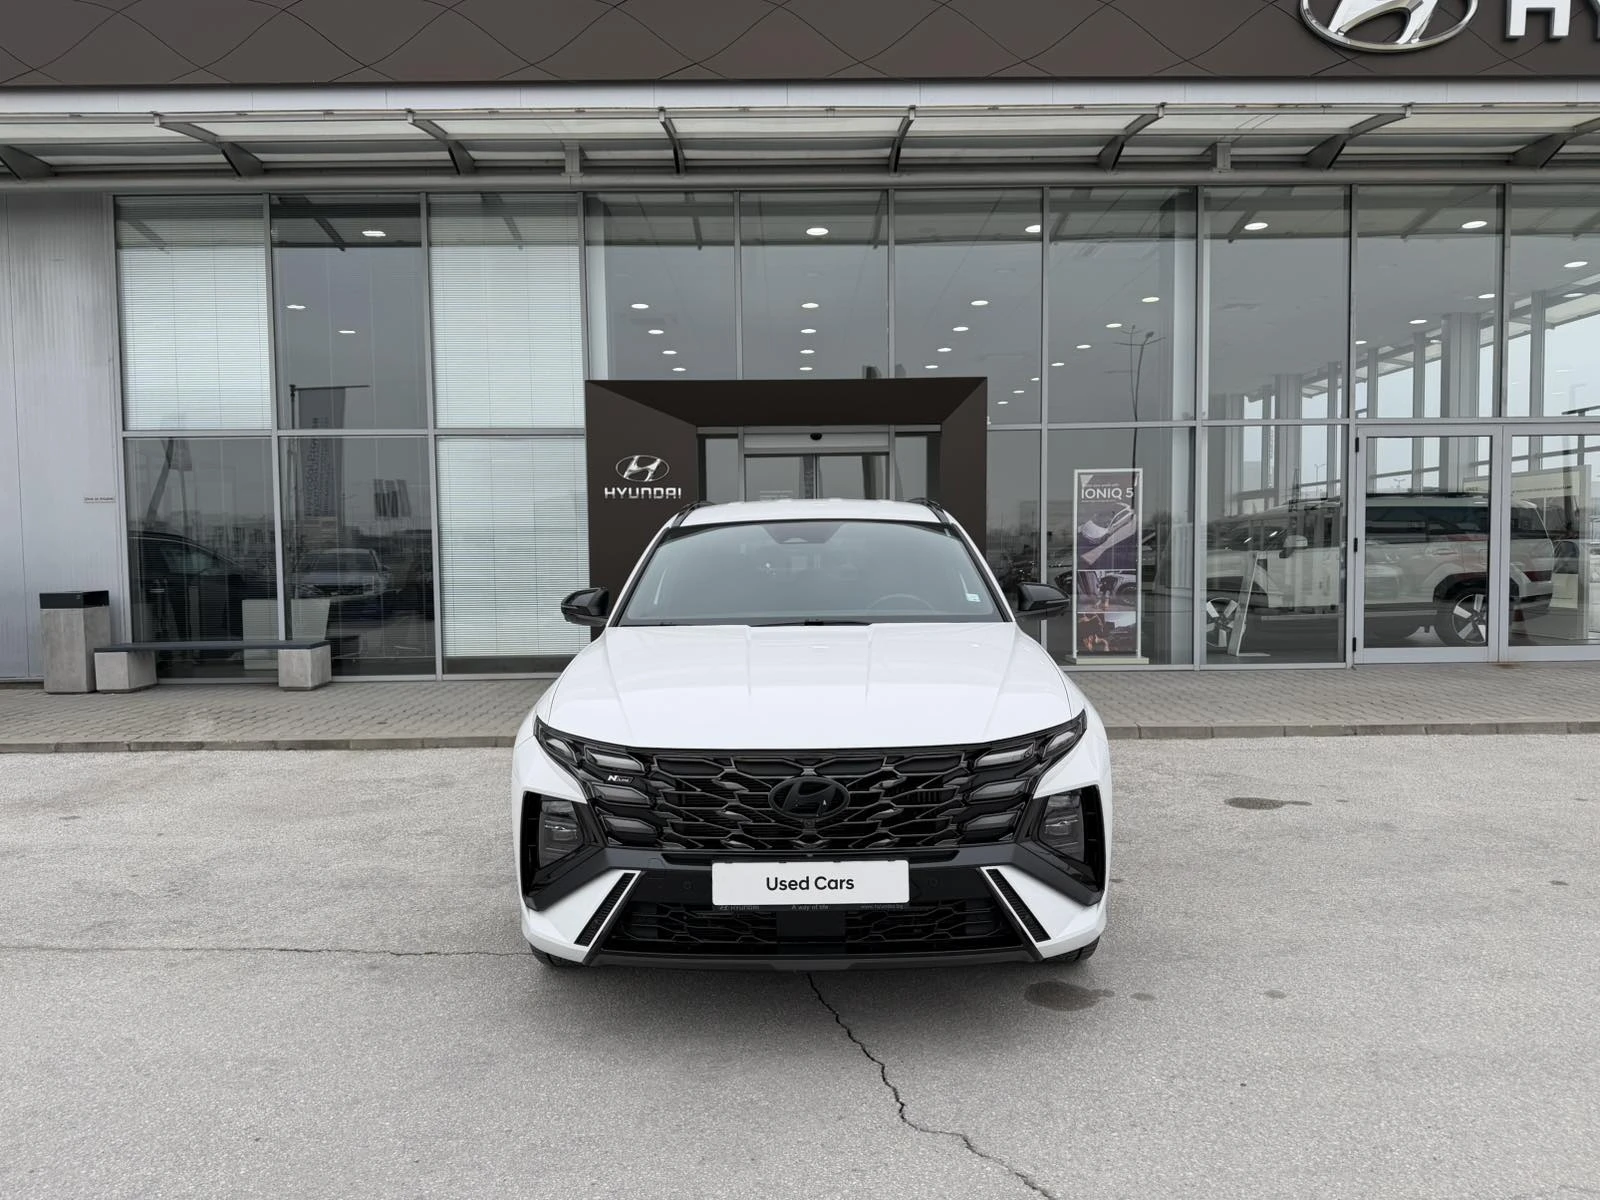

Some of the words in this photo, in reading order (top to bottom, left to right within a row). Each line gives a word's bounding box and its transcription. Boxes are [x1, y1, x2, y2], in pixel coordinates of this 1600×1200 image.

[604, 487, 682, 499] HYUNDAI
[1081, 487, 1122, 500] IONIQ
[1125, 487, 1134, 498] 5
[766, 876, 810, 891] Used
[814, 875, 855, 890] Cars
